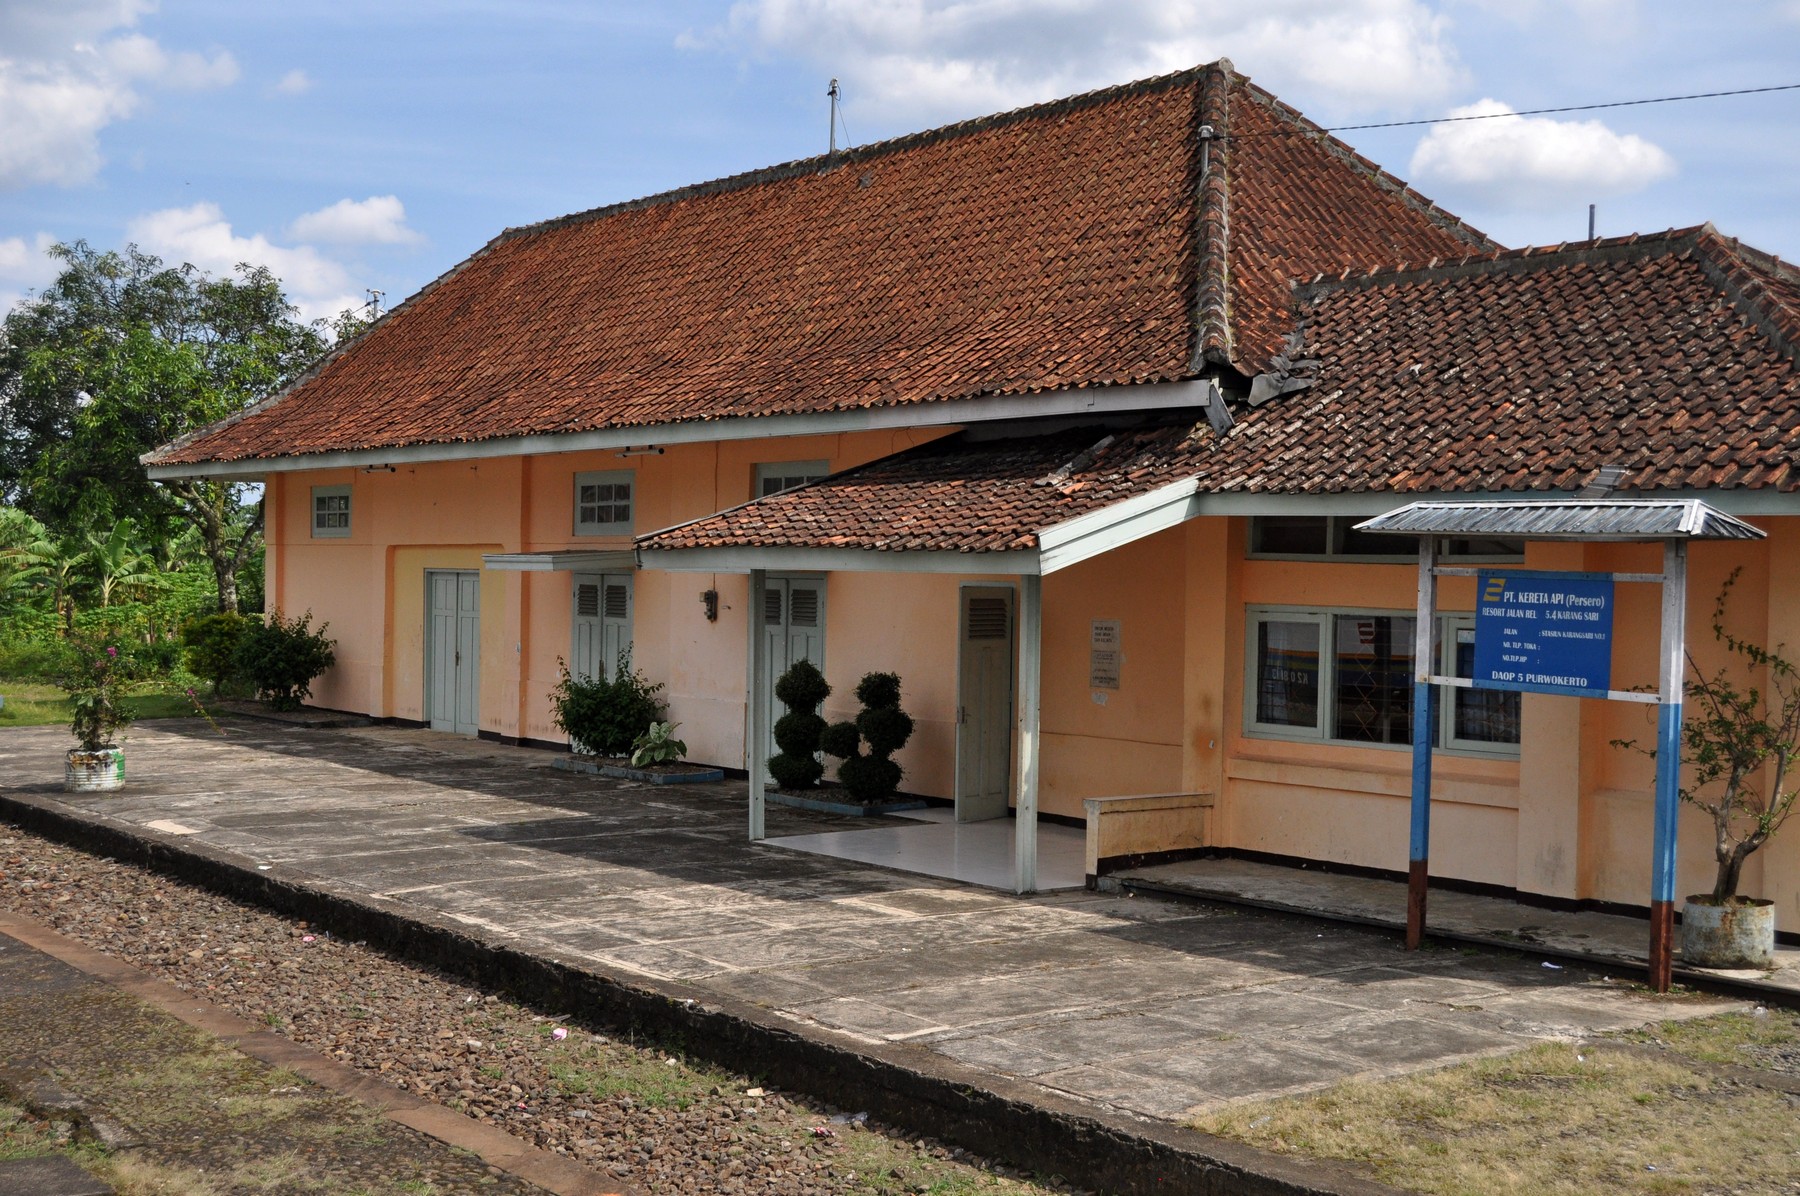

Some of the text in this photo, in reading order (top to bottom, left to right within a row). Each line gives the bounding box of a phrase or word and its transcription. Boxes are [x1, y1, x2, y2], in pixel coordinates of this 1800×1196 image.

[1504, 592, 1604, 608] PT. KERETA API (Persero)
[1482, 608, 1599, 621] RESORT JALAN REL 5.4 KARANG SARI
[1492, 671, 1515, 680] DAOP
[1526, 674, 1587, 686] PURWOKERTO
